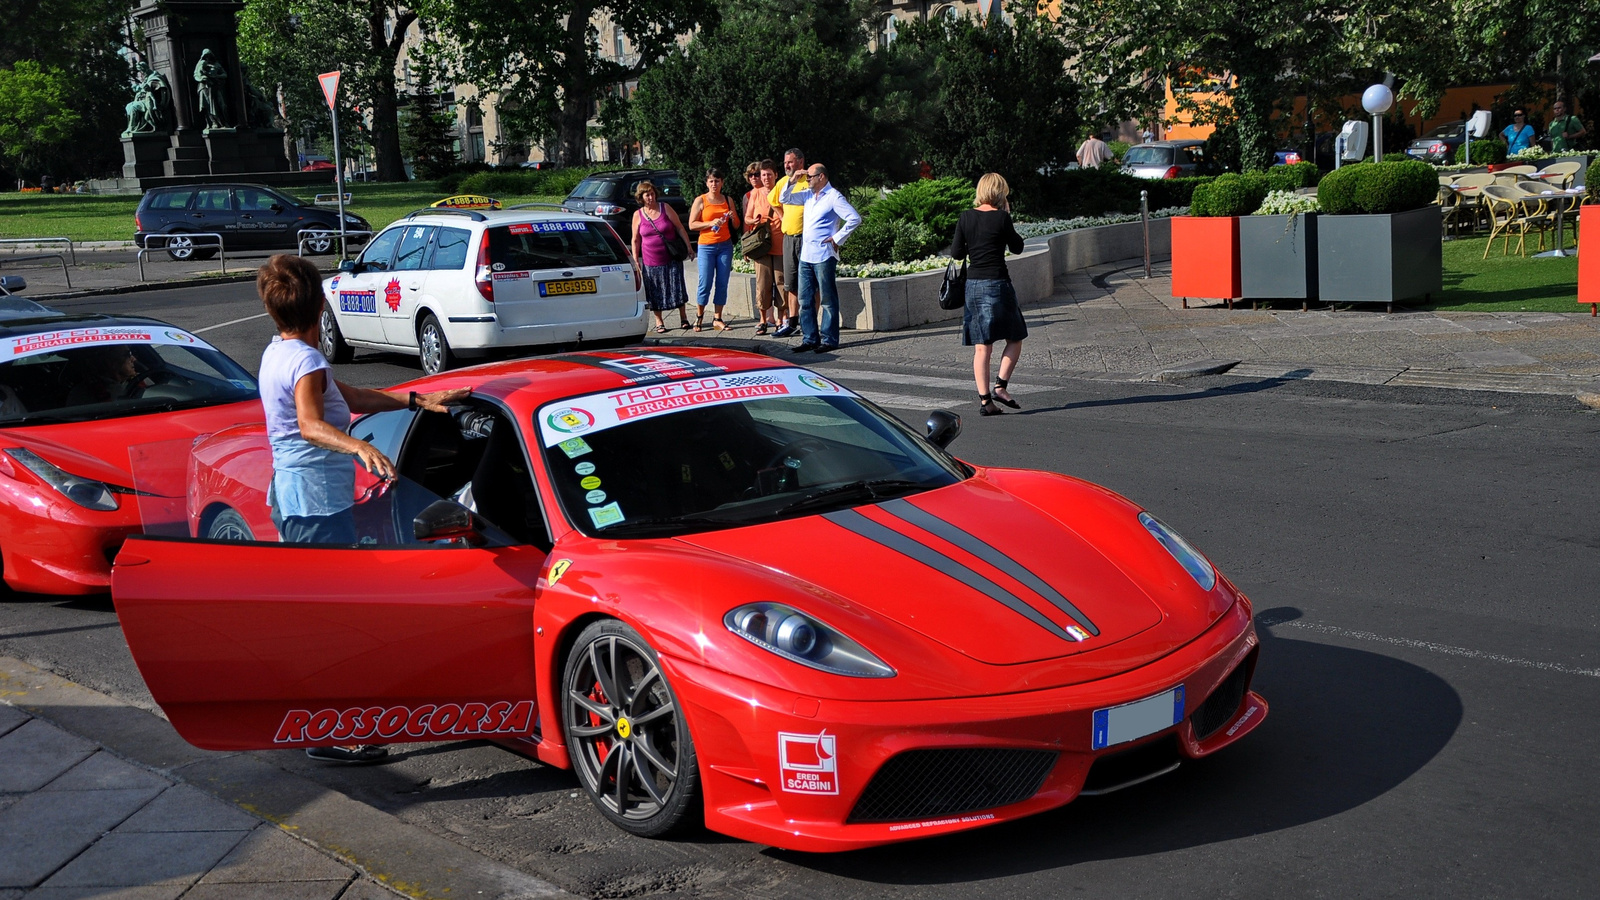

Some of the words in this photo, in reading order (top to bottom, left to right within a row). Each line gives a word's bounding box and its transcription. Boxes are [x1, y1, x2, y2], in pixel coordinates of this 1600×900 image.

[532, 222, 586, 232] 8-888-000
[341, 295, 376, 312] 8-888-000
[12, 329, 99, 345] TROFEO
[22, 338, 70, 351] FERRARI
[71, 335, 107, 345] CLUB
[622, 374, 656, 384] ADVANCED
[607, 378, 720, 406] TROFEO
[627, 394, 690, 417] FERRARI
[692, 388, 733, 403] CLUB
[735, 384, 782, 398] ITALIA
[273, 700, 535, 743] ROSSOCORSA
[787, 778, 831, 791] SCABINI
[796, 773, 819, 781] EREDI
[889, 823, 921, 831] ADVANCED
[922, 818, 960, 827] REFRACTORY
[961, 814, 995, 822] SOLUTIONS
